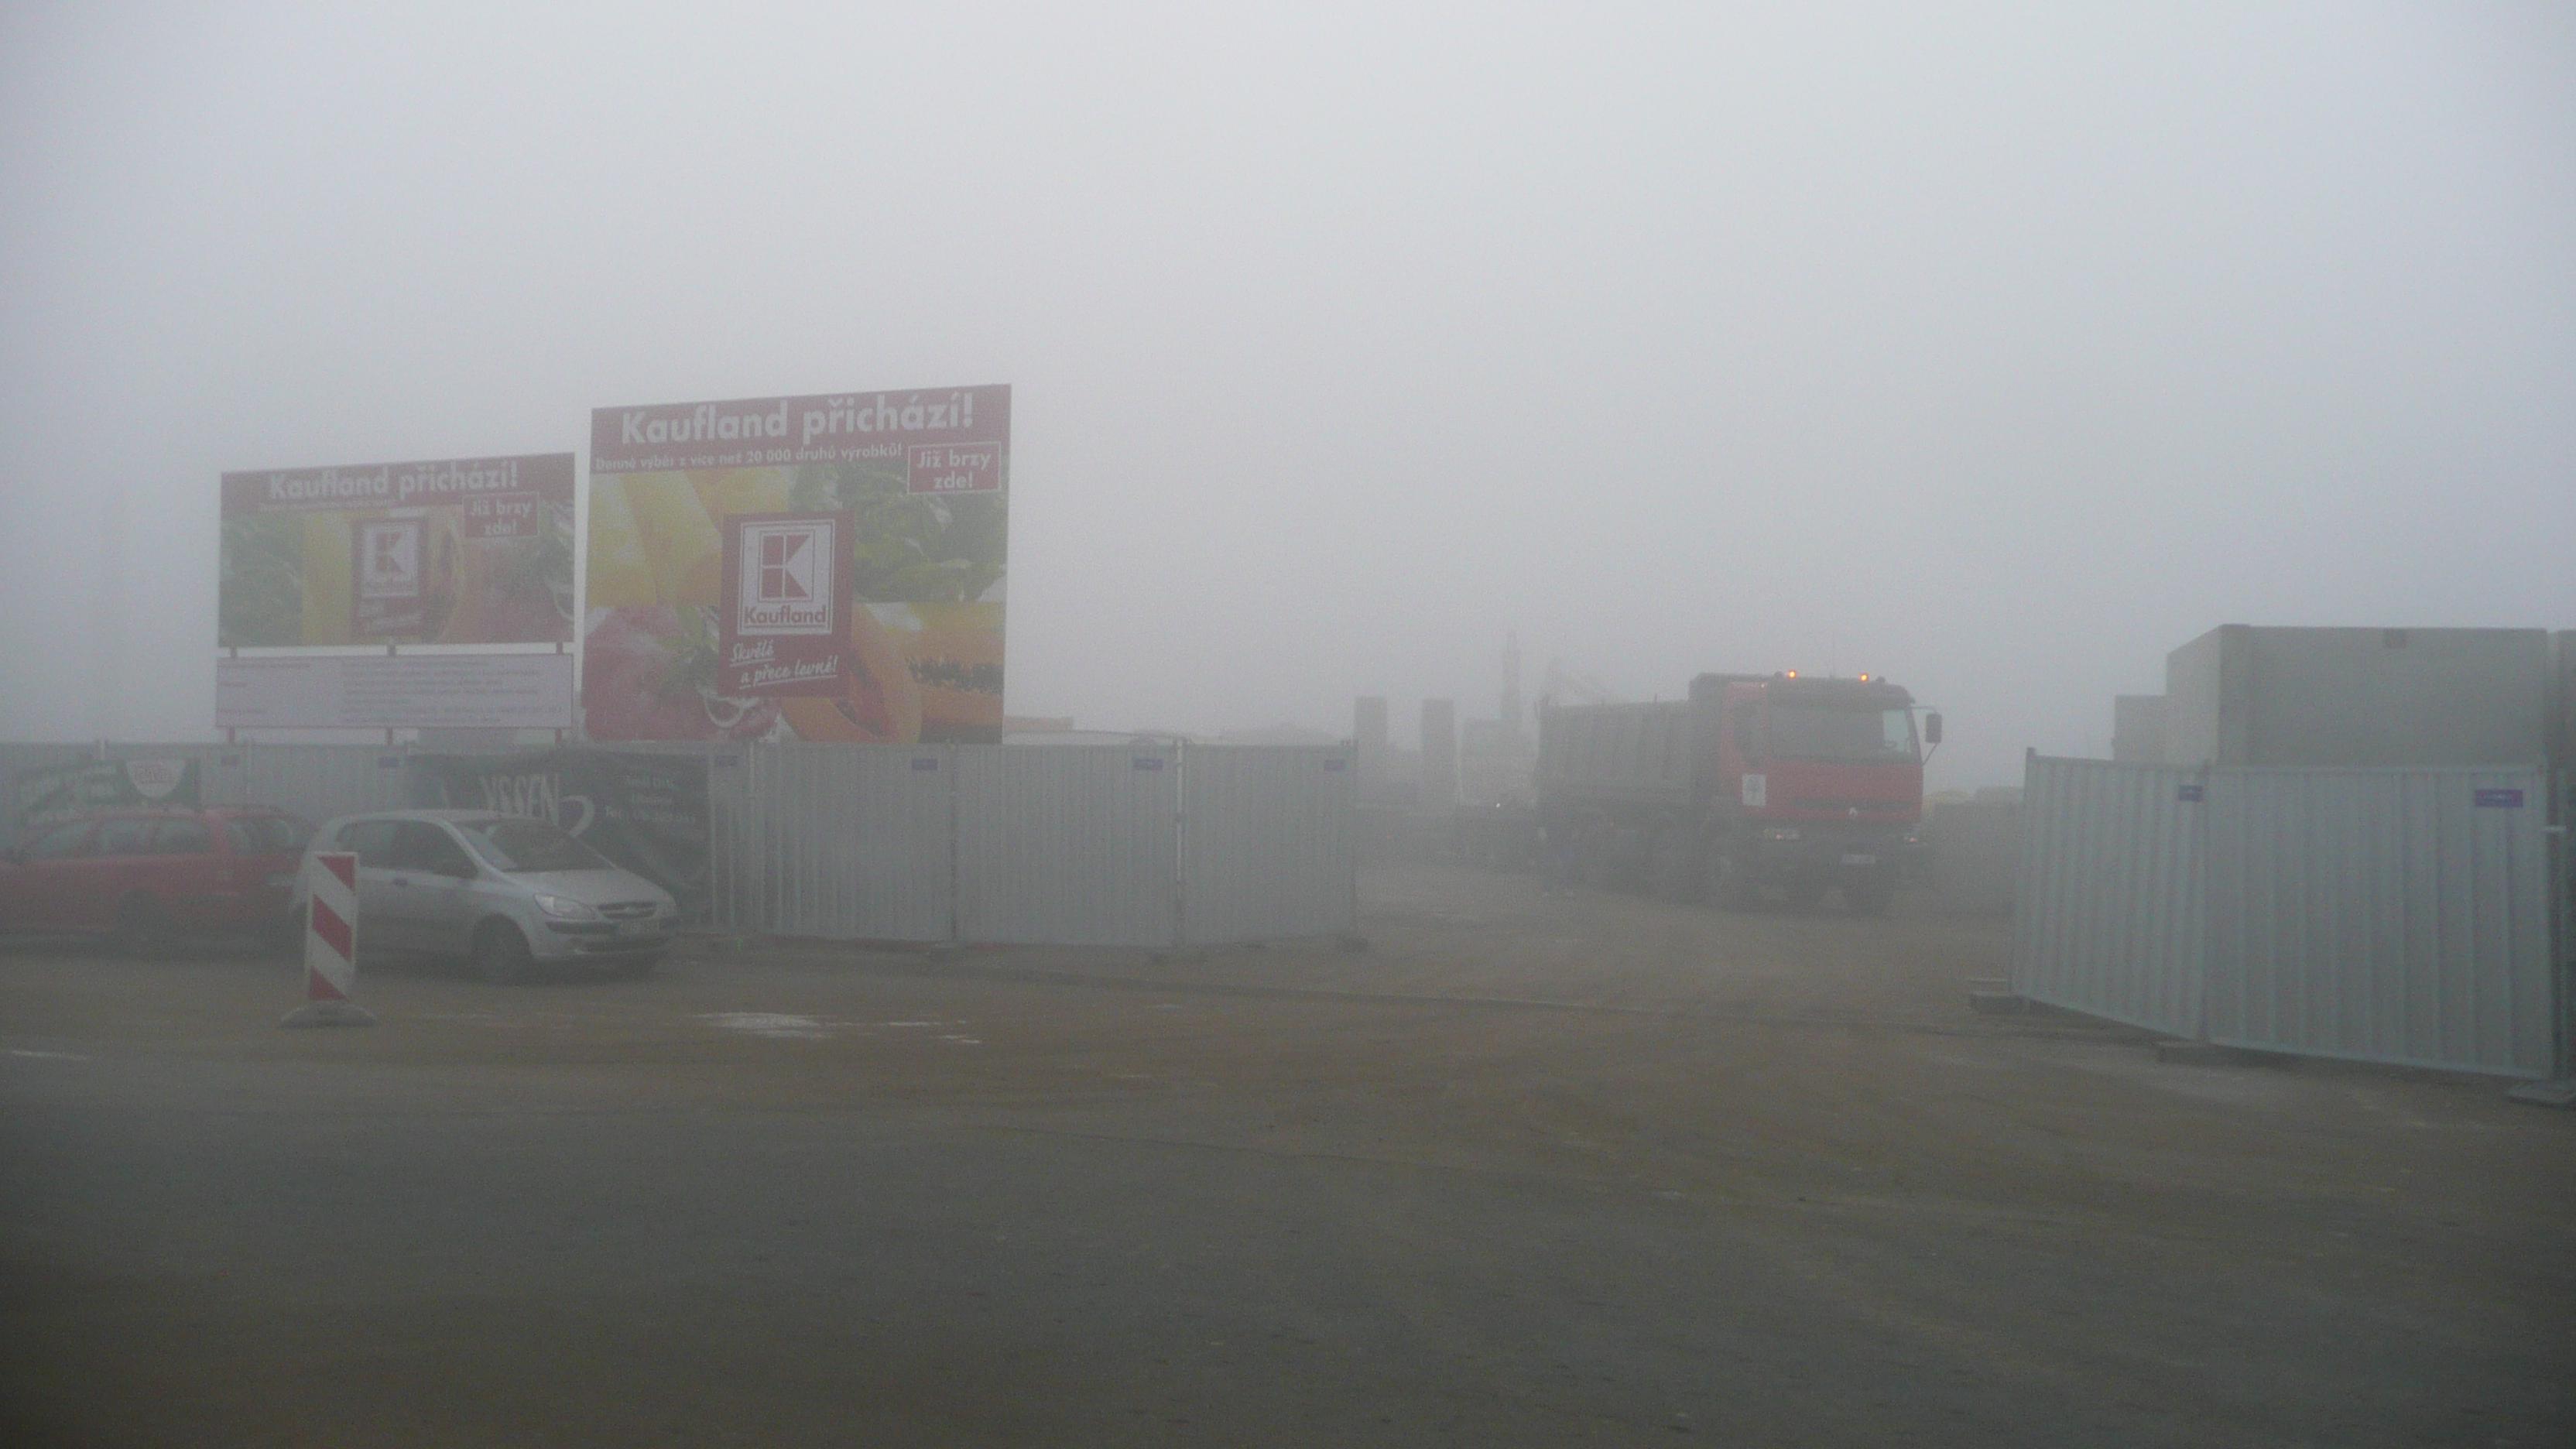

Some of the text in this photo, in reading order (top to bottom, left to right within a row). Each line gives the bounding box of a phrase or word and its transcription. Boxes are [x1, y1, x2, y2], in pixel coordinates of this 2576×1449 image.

[622, 391, 973, 445] Kaufland přichází!
[746, 449, 763, 463] 20
[766, 448, 792, 462] 000
[916, 447, 991, 471] Již brzy
[269, 459, 519, 502] Kaufland přichází!
[933, 470, 974, 490] zde!
[744, 605, 827, 625] Kaufland
